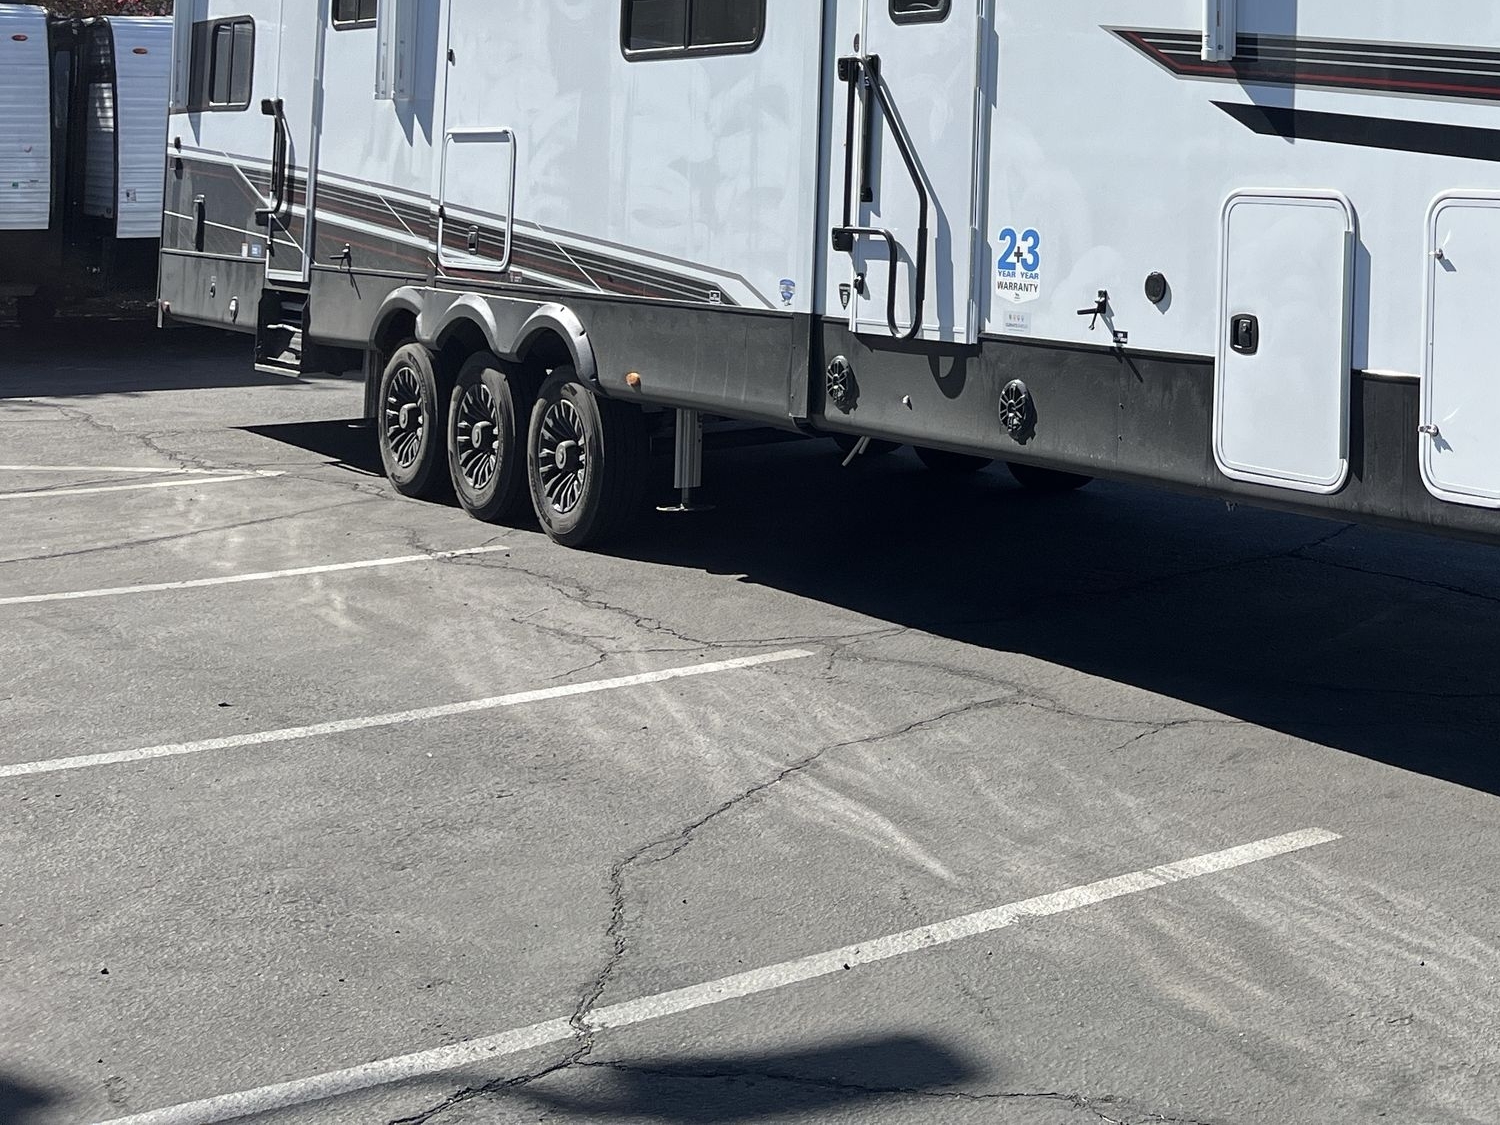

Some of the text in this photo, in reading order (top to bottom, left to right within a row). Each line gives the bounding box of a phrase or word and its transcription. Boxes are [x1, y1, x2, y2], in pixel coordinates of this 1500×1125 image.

[997, 270, 1039, 280] YEAR YEAR
[997, 281, 1039, 293] WARRANTY
